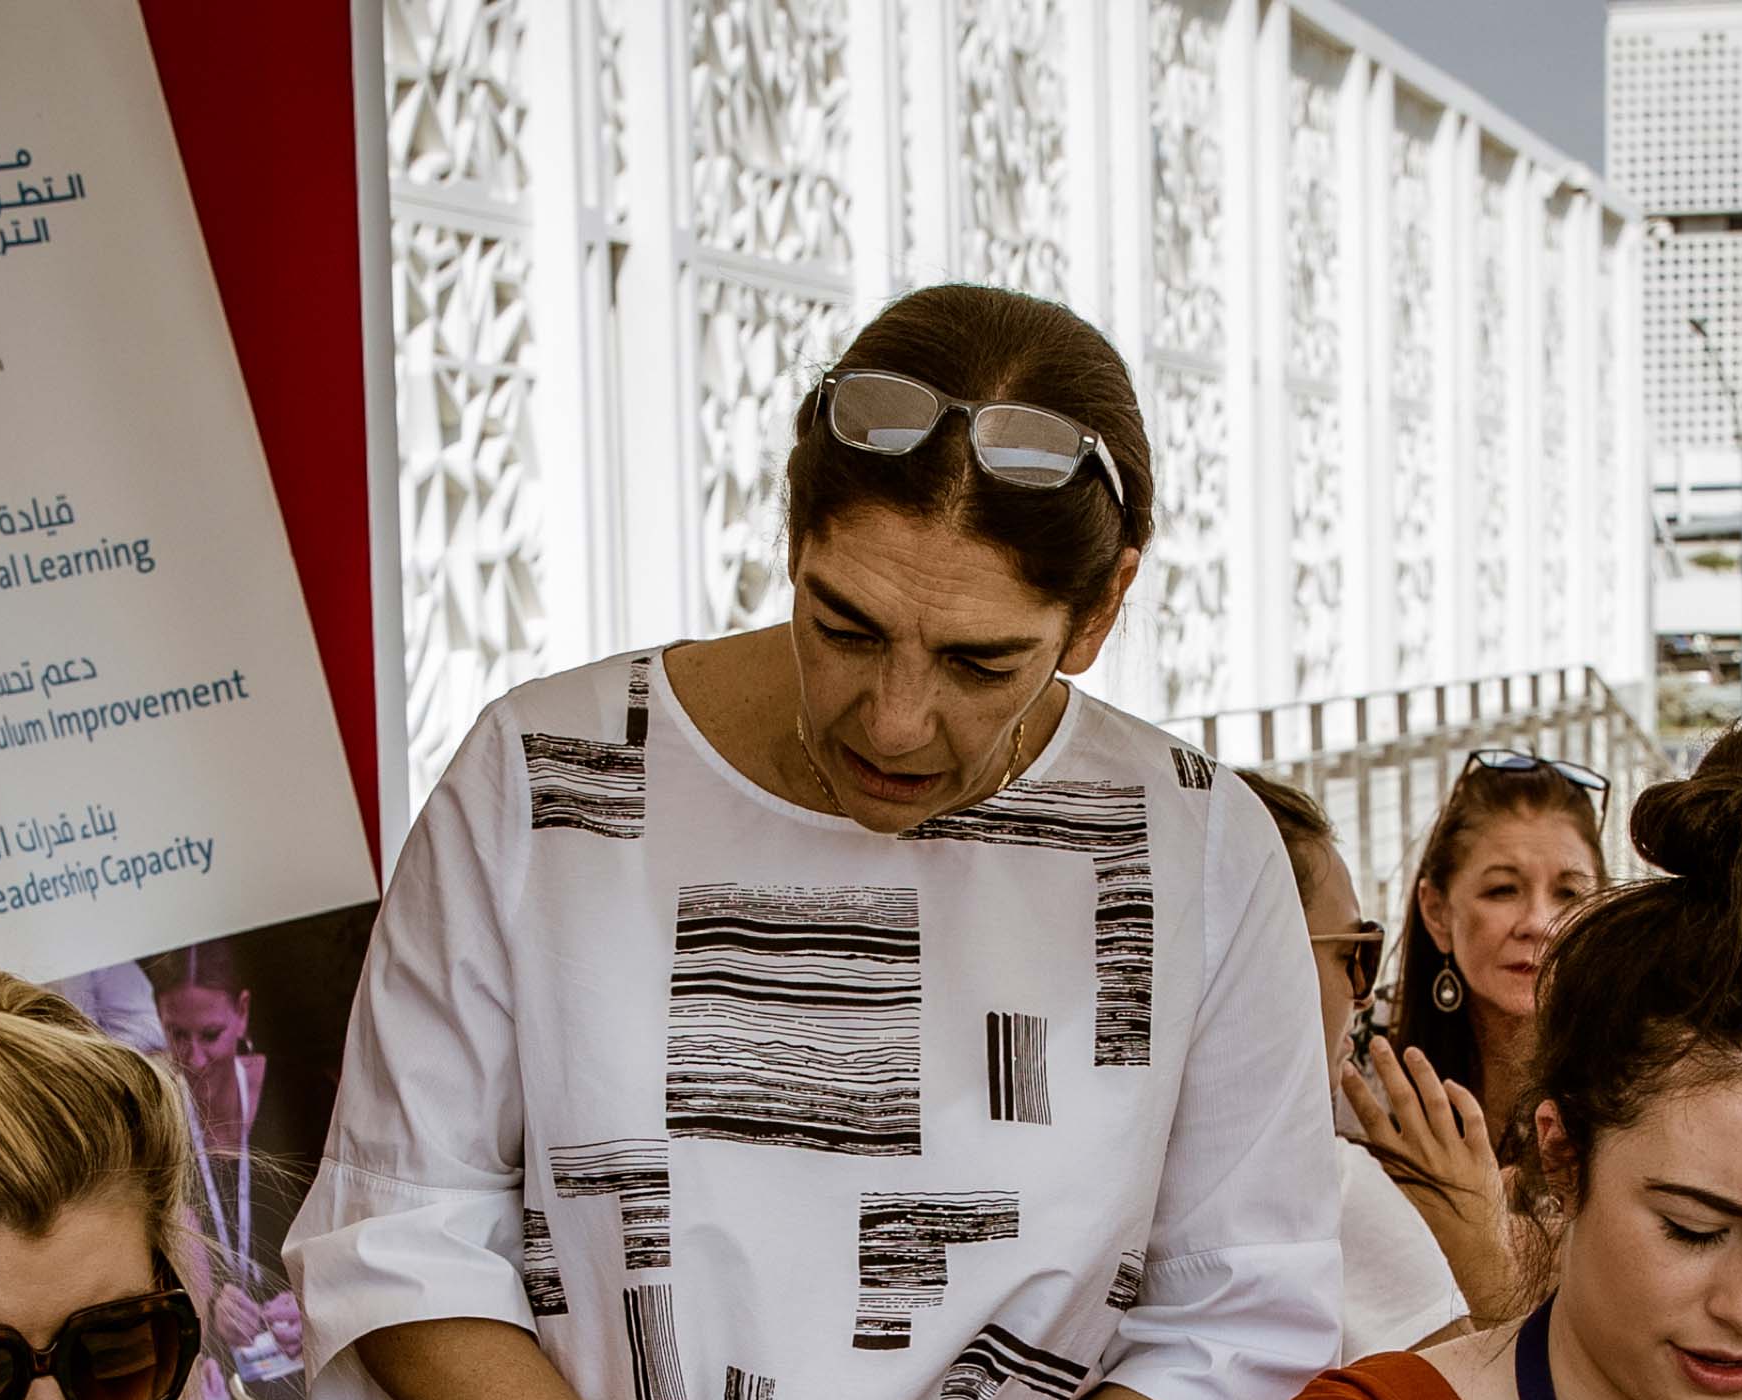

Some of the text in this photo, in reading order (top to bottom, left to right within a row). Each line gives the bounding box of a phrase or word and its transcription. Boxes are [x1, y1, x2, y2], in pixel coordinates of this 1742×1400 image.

[25, 537, 156, 585] Learning
[42, 656, 98, 699] دعم
[48, 670, 250, 742] Improvement
[15, 813, 76, 859] قدرات
[80, 804, 118, 843] بناء
[100, 837, 215, 890] Capacity
